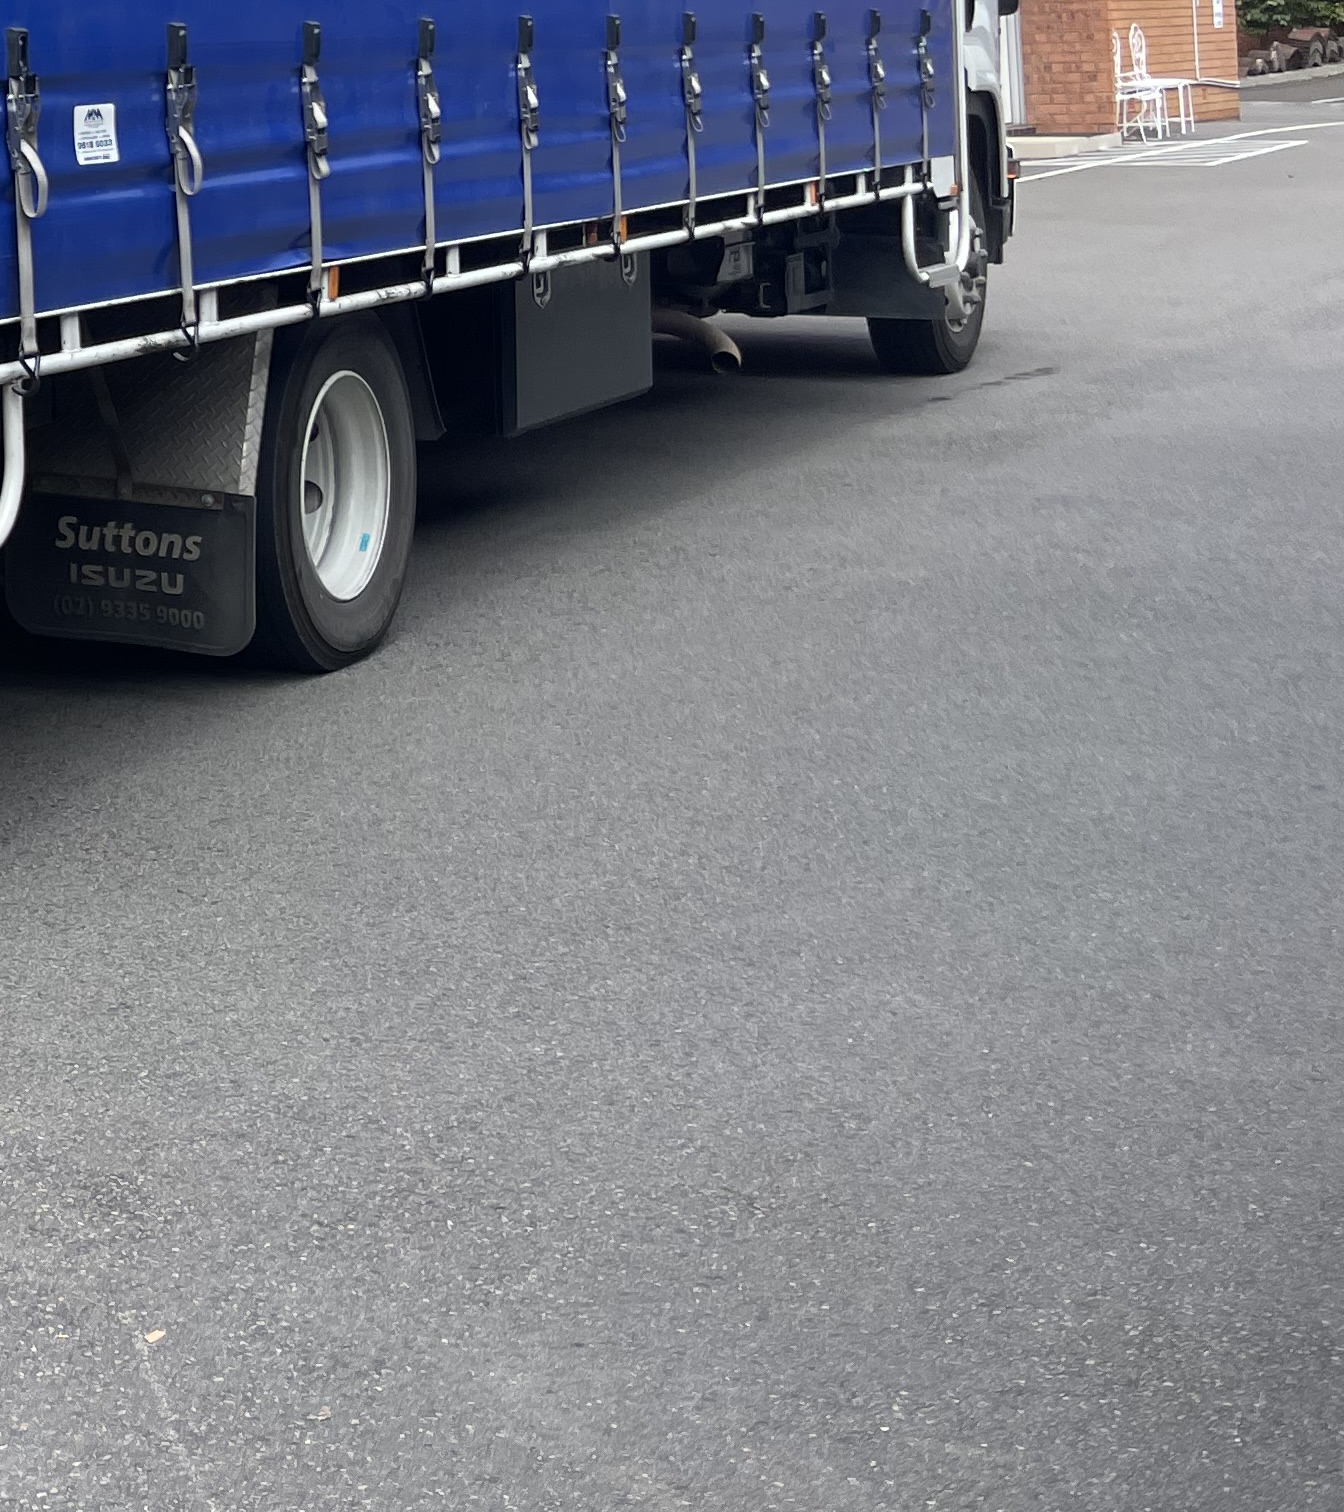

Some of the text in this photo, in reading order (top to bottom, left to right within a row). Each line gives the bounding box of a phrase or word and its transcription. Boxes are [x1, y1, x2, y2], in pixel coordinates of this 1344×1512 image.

[55, 515, 202, 561] Suttons
[69, 563, 185, 595] ISUZU
[101, 599, 151, 622] 9335
[156, 605, 205, 630] 9000
